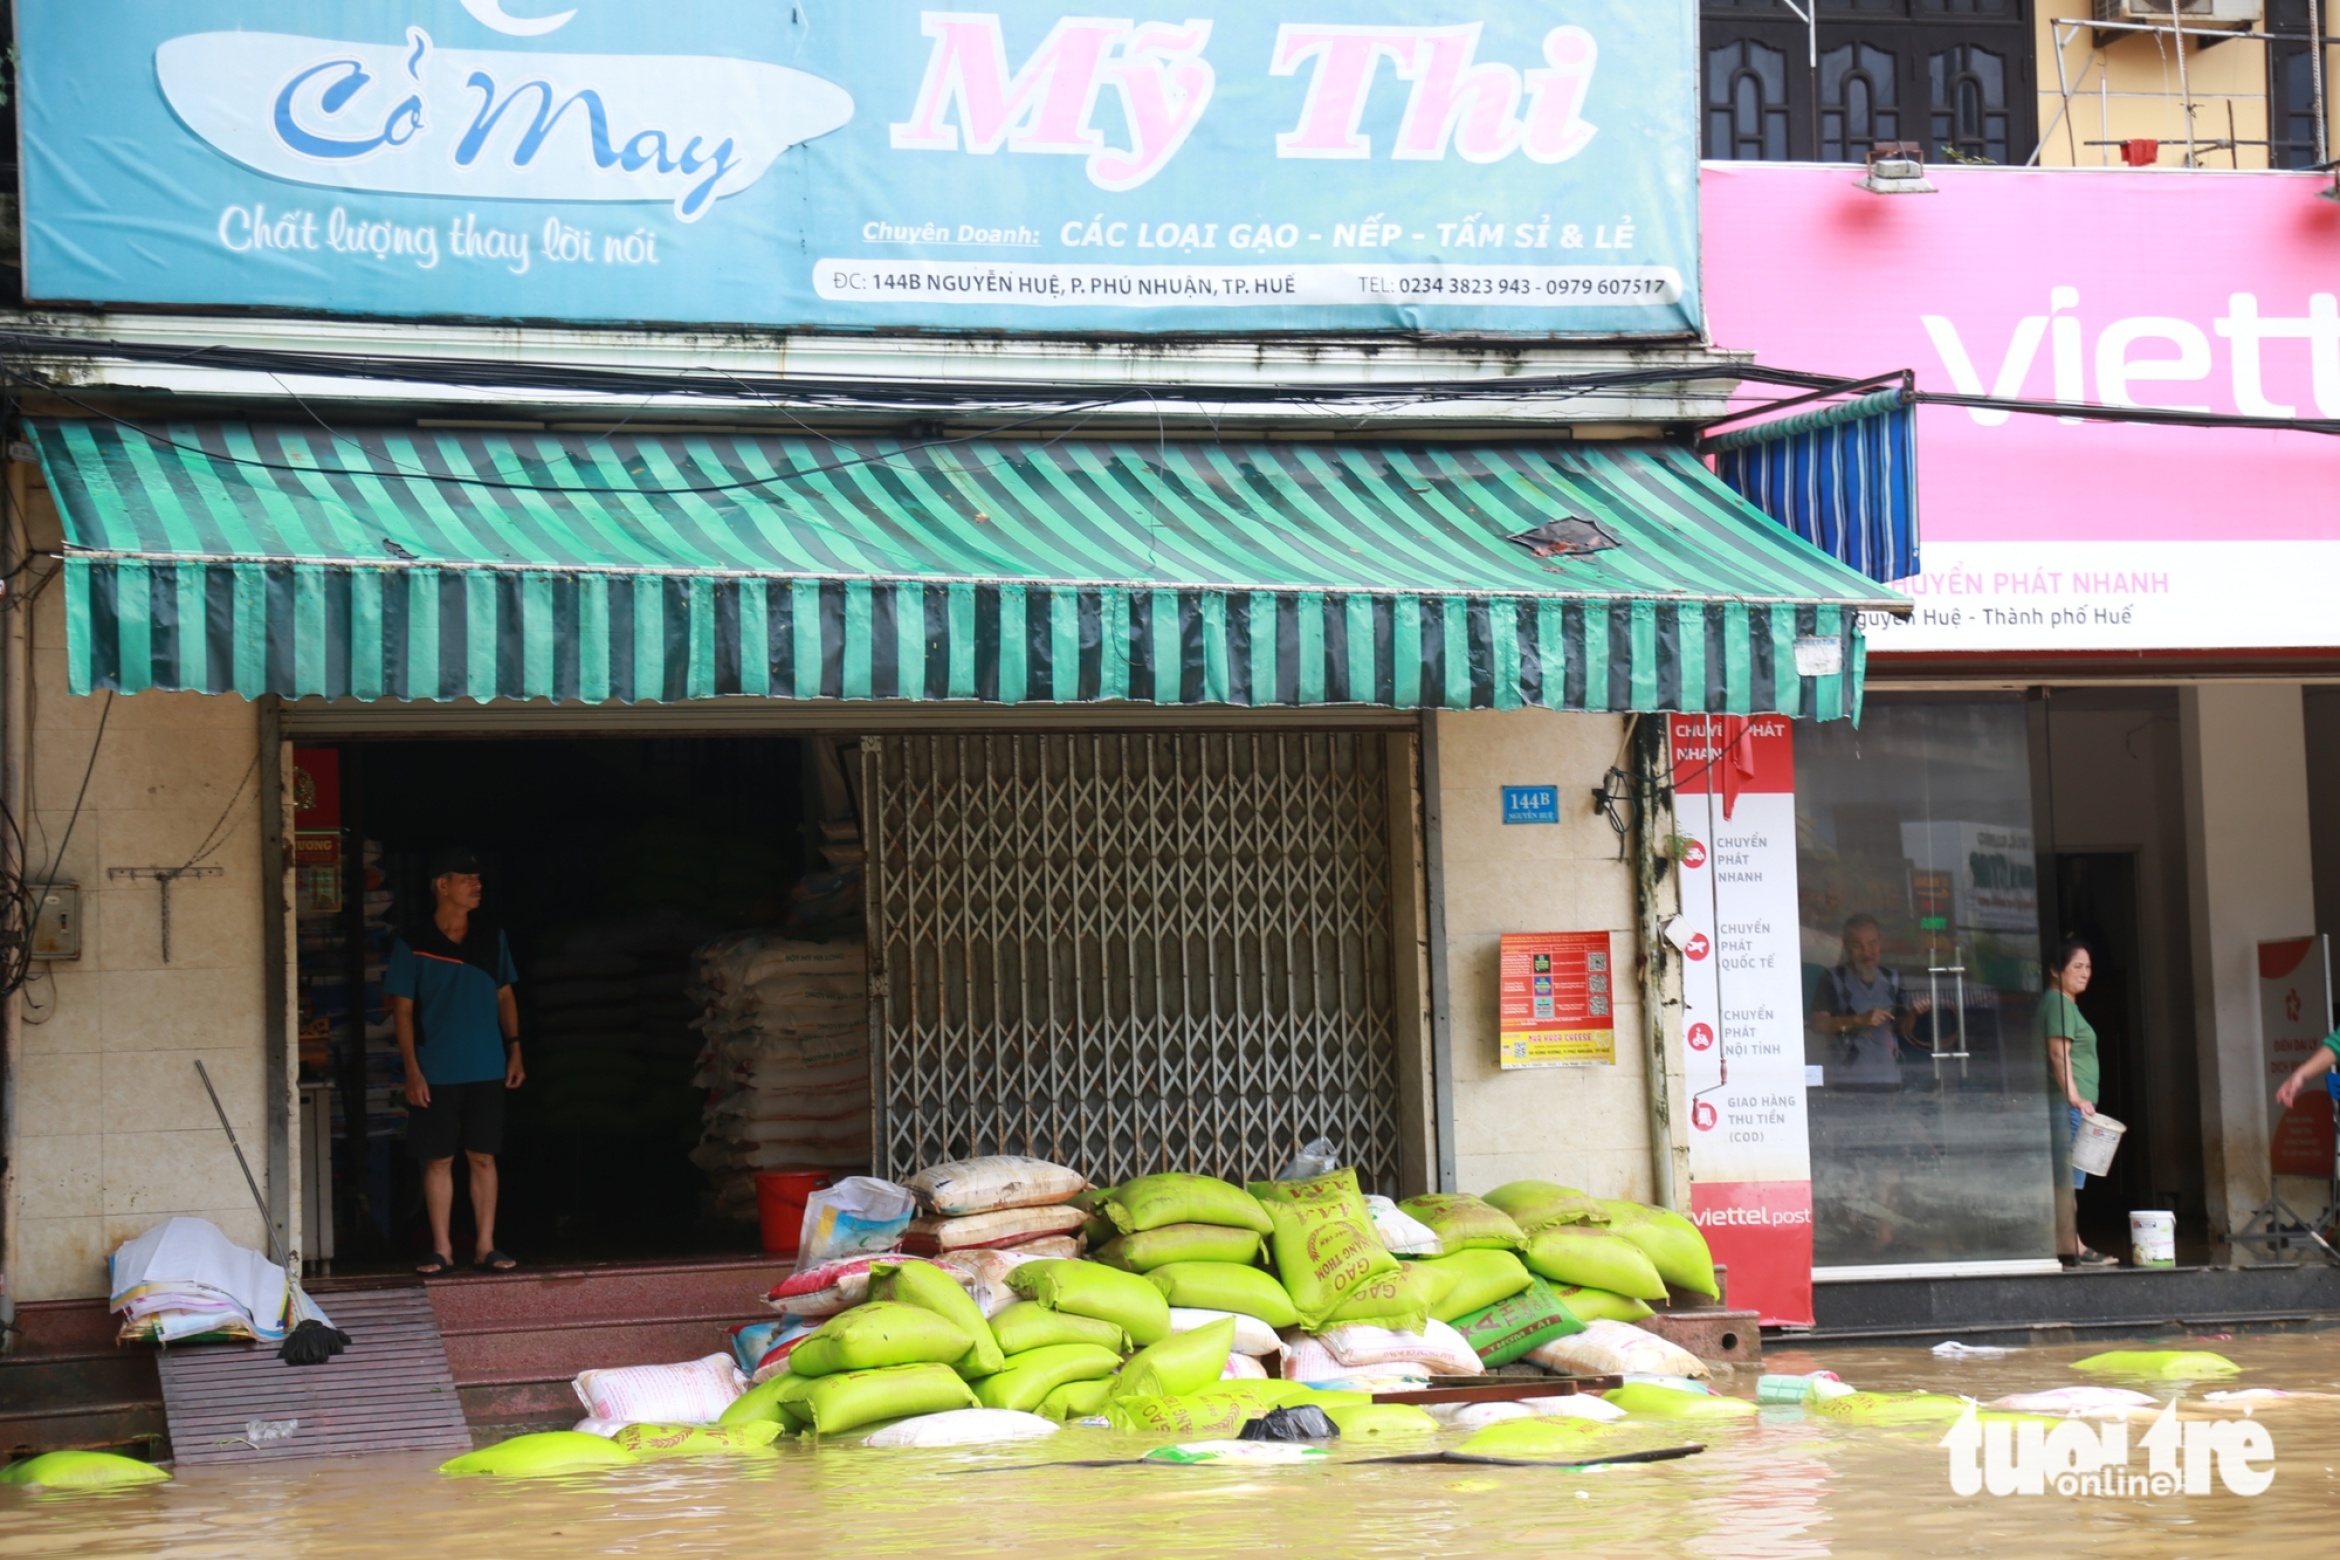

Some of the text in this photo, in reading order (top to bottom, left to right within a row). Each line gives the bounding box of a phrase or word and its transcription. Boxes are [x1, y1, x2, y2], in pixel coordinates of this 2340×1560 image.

[889, 11, 1599, 193] Mỹ Thi
[270, 27, 745, 219] Cỏ May
[219, 203, 660, 275] Chất lượng thay lời nói
[862, 221, 949, 245] Chuyên
[957, 224, 1040, 244] Doanh:
[1060, 214, 1127, 247] CÁC
[1138, 223, 1219, 254] LOẠI
[1228, 223, 1298, 254] GẠO
[1333, 213, 1402, 248] NẾP
[1437, 212, 1504, 248] TẤM
[1514, 214, 1549, 249] SỈ
[1560, 225, 1584, 249] &
[1595, 215, 1635, 249] LẺ
[833, 272, 867, 290] ĐC:
[872, 273, 921, 290] 144B
[927, 269, 1013, 292] NGUYỄN
[1019, 274, 1065, 298] HUỆ,
[1071, 277, 1086, 294] P.
[1090, 274, 1131, 295] PHÚ
[1138, 273, 1218, 298] NHUẬN,
[1222, 278, 1250, 295] TP.
[1255, 272, 1296, 294] HUẾ
[1358, 276, 1395, 294] TEL:
[1399, 277, 1444, 294] 0234
[1448, 278, 1494, 295] 3823
[1498, 278, 1531, 295] 943
[1545, 279, 1592, 296] 0979
[1597, 279, 1666, 296] 607517
[1892, 561, 2169, 596] HUYỂN PHÁT NHANH
[1924, 608, 1961, 628] Huệ
[1983, 607, 2043, 626] Thành
[2051, 604, 2087, 630] phố
[2094, 603, 2134, 625] Huế
[1676, 747, 1723, 761] NHAN
[1510, 792, 1550, 810] 144B
[1717, 832, 1767, 848] CHUYỂN
[1718, 852, 1750, 866] PHÁT
[1718, 872, 1763, 883] NHANH
[1720, 918, 1770, 935] CHUYỂN
[1721, 938, 1753, 952] PHÁT
[1722, 952, 1776, 971] QUỐC TẾ
[1724, 1004, 1774, 1021] CHUYỂN
[1725, 1025, 1756, 1038] PHÁT
[1726, 1042, 1781, 1058] NỘI TỈNH
[1728, 1093, 1796, 1108] GIAO HÀNG
[1728, 1109, 1785, 1125] THU TIỀN
[1729, 1131, 1765, 1143] (COD)
[1691, 1206, 1811, 1227] viettel post
